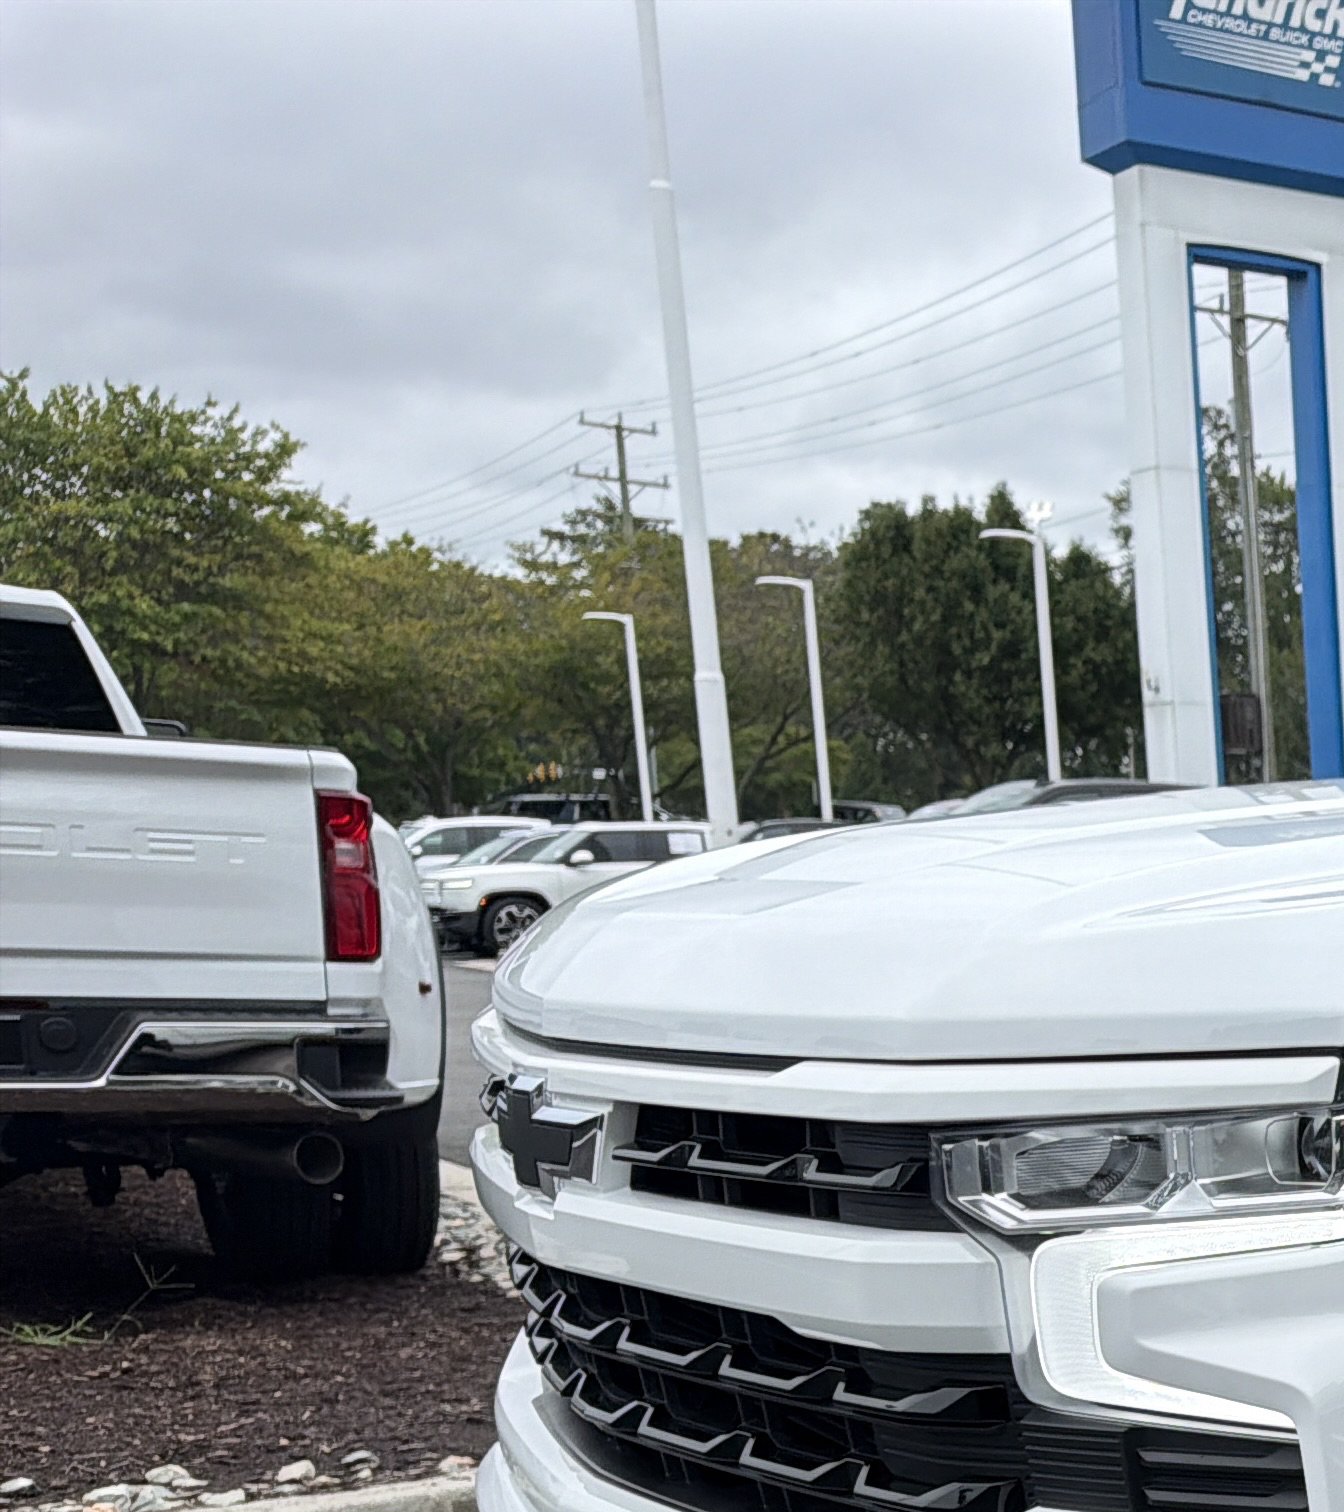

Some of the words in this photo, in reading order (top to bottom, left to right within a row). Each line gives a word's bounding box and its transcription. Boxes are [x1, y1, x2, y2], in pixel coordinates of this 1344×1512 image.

[1186, 9, 1268, 37] CHEVROLET
[1268, 27, 1311, 48] BUICK
[1312, 36, 1344, 54] GMC
